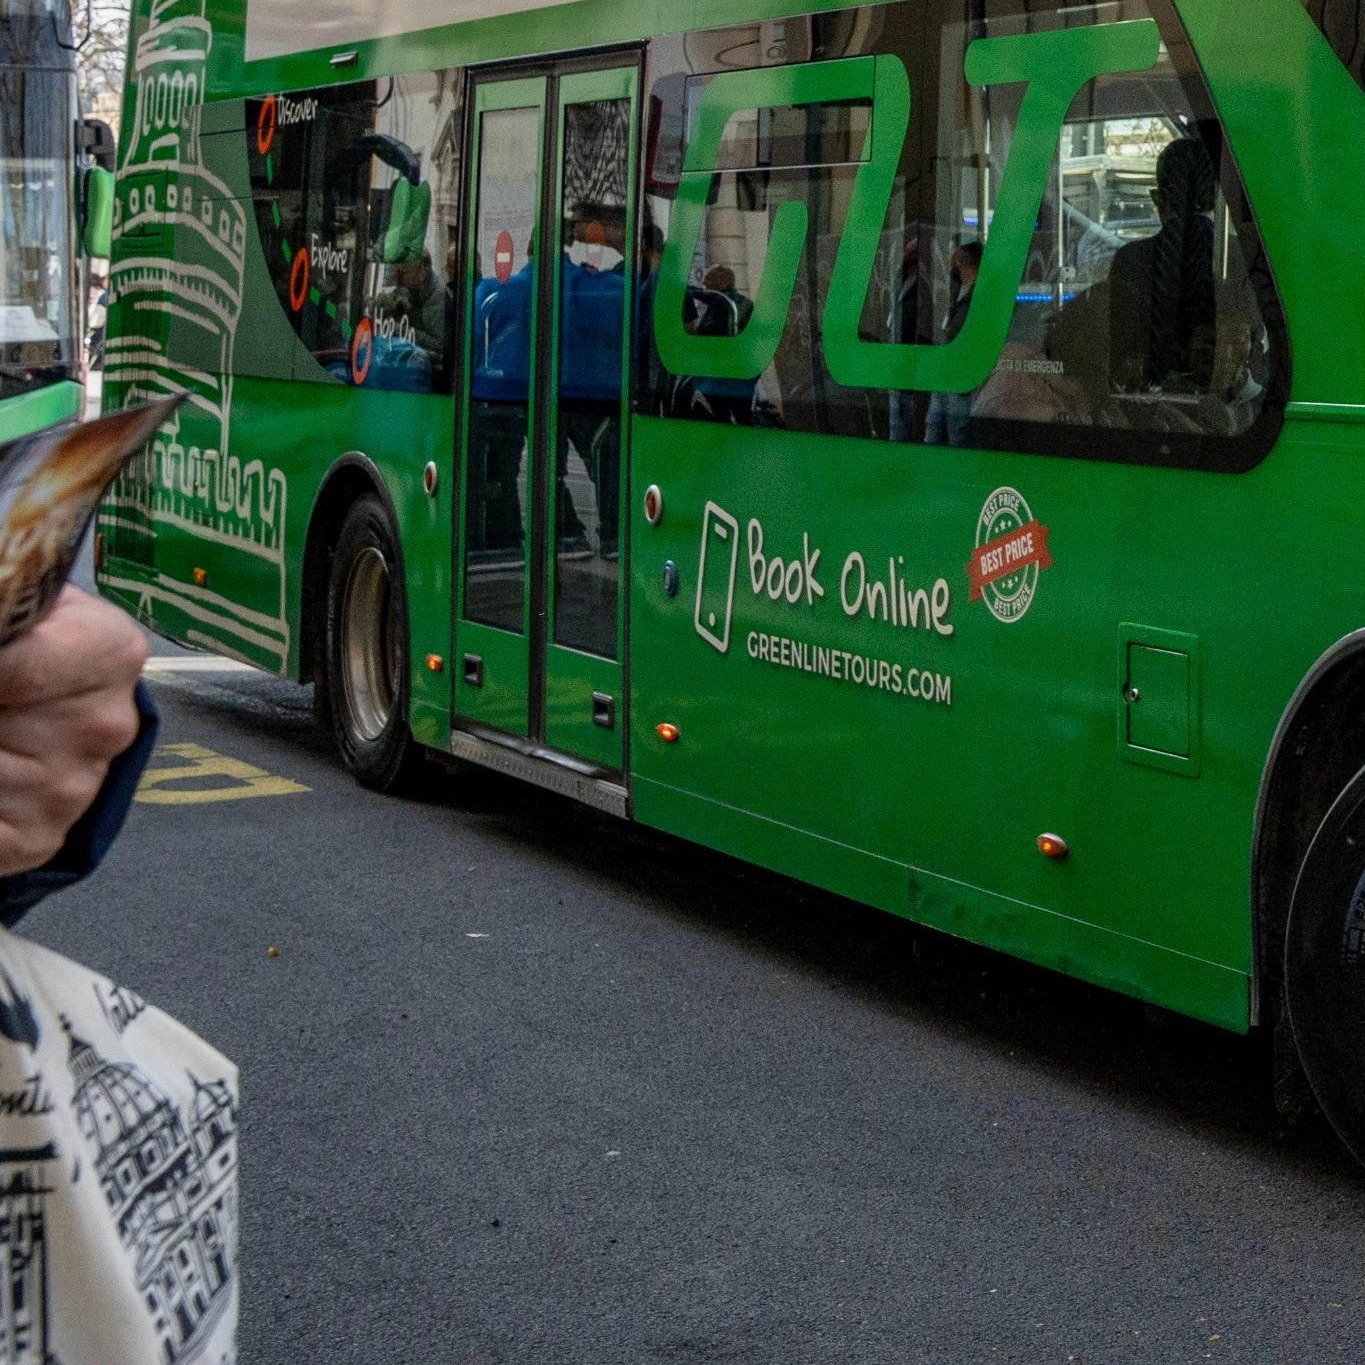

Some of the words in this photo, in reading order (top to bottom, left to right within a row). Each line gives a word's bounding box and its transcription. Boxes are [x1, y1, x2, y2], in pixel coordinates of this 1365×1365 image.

[277, 93, 318, 126] Discover
[311, 233, 347, 279] Explore
[374, 307, 394, 350] Hop
[399, 314, 416, 345] On
[982, 498, 998, 527] BEST
[999, 493, 1020, 512] PRICE
[980, 546, 1004, 576] BEST
[1005, 532, 1034, 564] PRICE
[747, 517, 824, 605] Book
[840, 551, 954, 636] Online
[993, 597, 1011, 616] BEST
[1012, 583, 1031, 615] PRICE
[747, 631, 952, 706] GREENLINETOURS.COM
